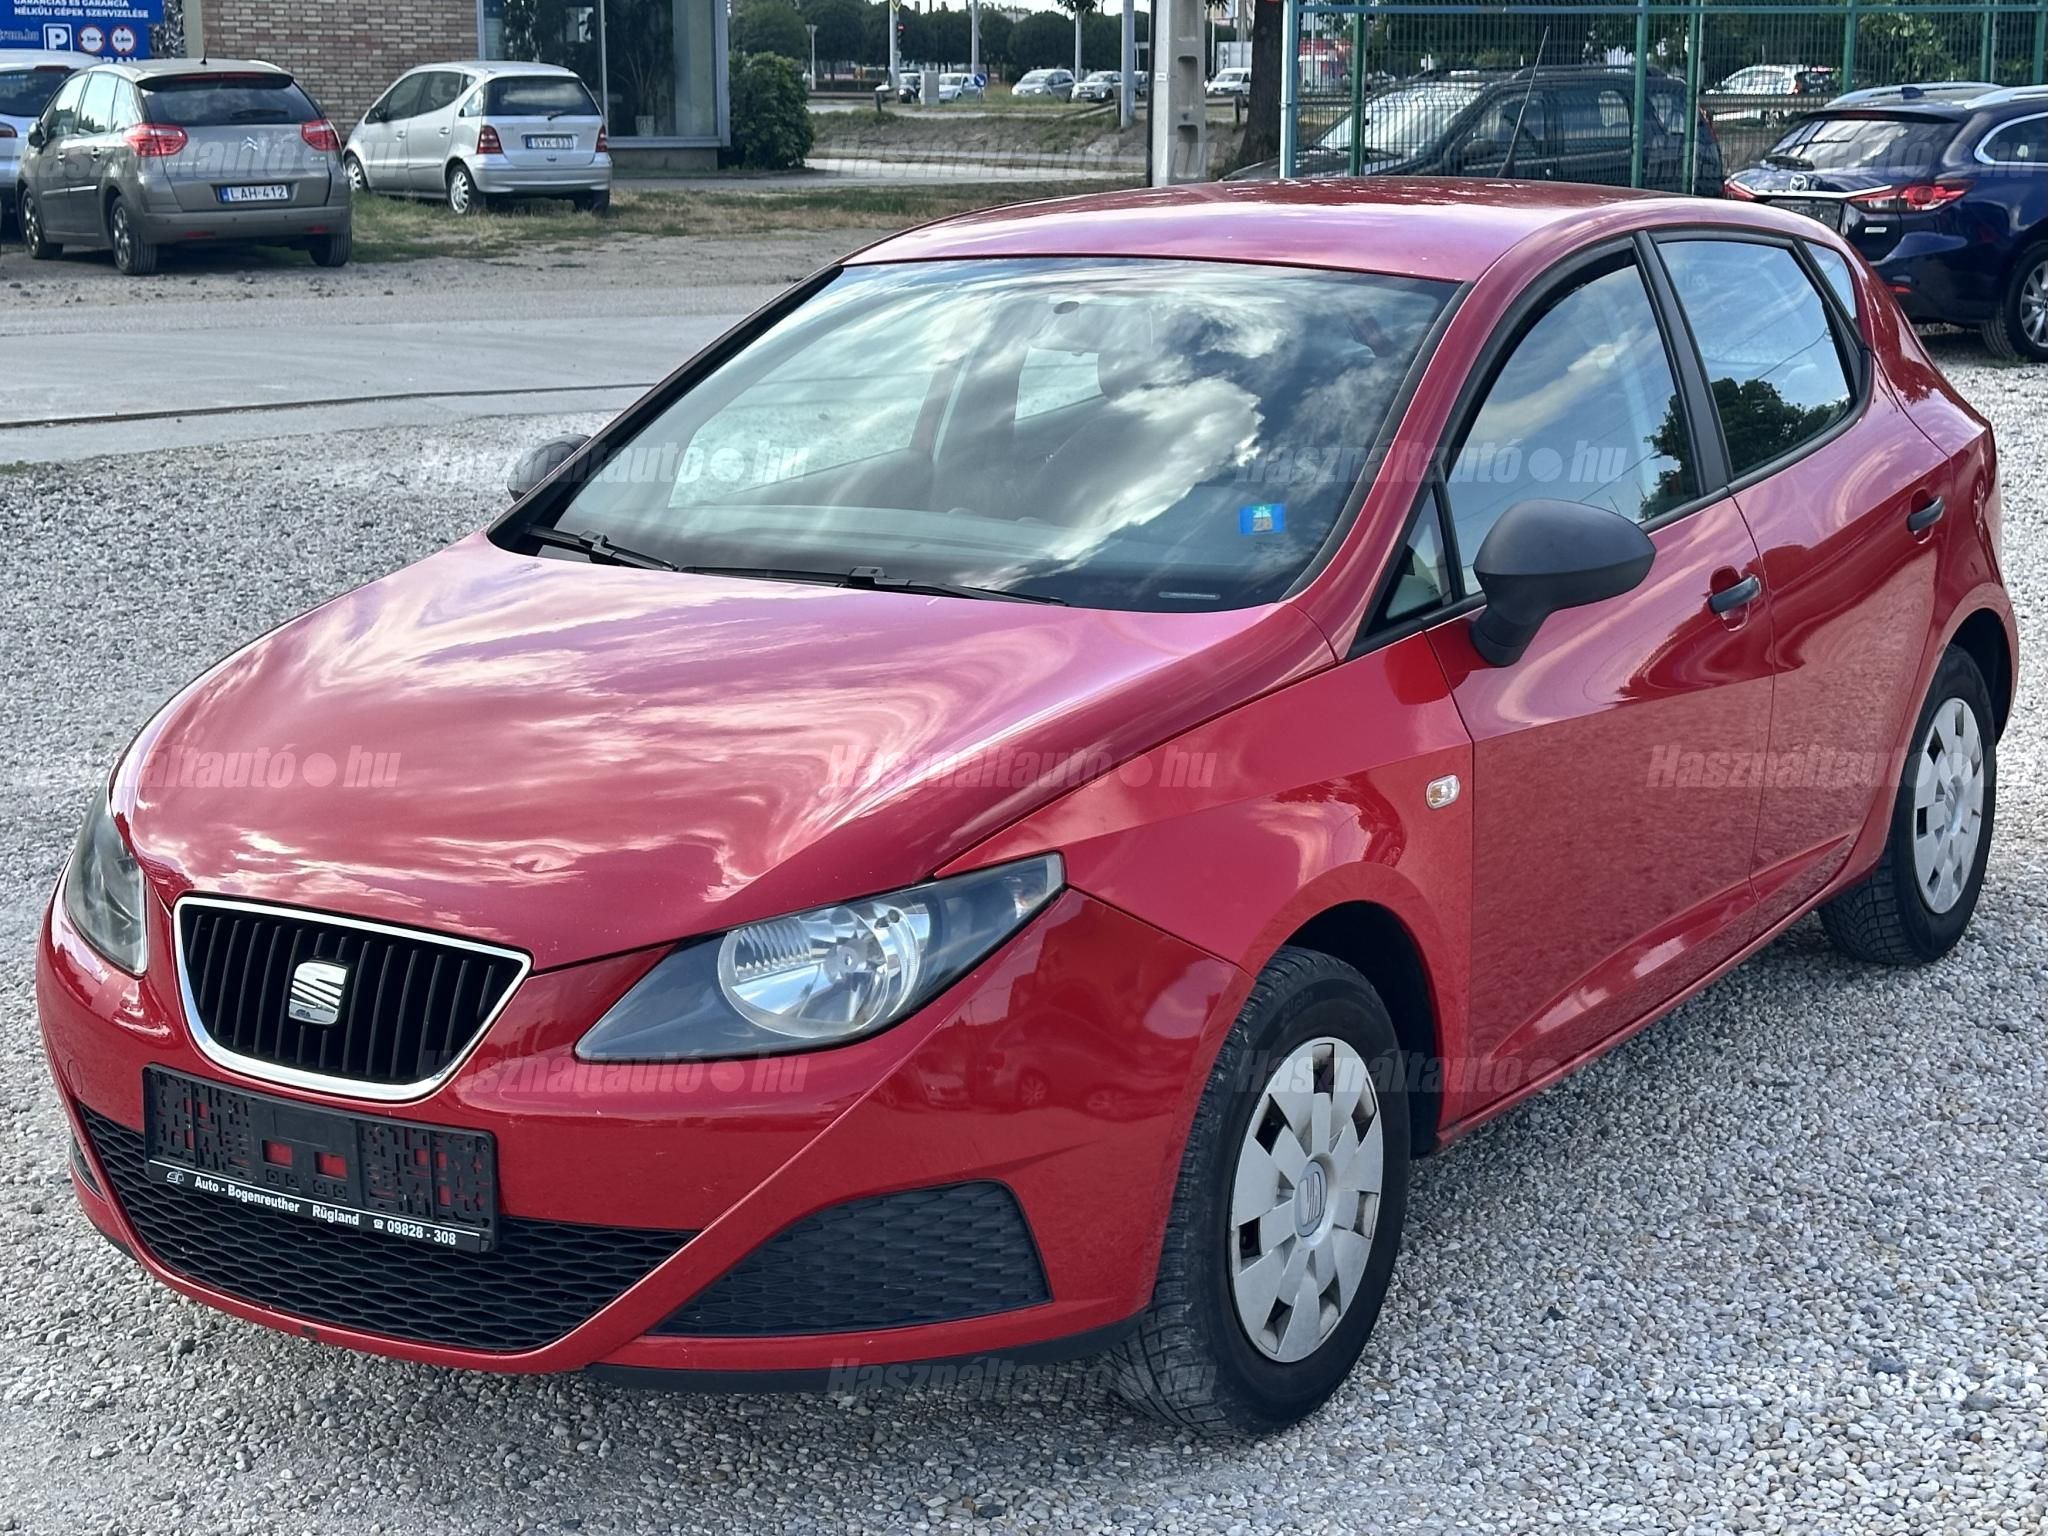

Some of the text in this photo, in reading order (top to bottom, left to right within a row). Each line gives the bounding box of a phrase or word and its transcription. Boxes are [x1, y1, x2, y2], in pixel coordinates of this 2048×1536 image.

[14, 6, 149, 18] NÉLKÜLI GÉPEK SZERVIZELÉSE
[48, 28, 68, 50] P
[230, 186, 286, 200] LAH-412
[194, 1175, 219, 1193] Auto
[228, 1184, 300, 1213] Bogenreuther
[312, 1204, 360, 1226] Rügland
[387, 1219, 424, 1239] 09828
[433, 1229, 457, 1246] 308
